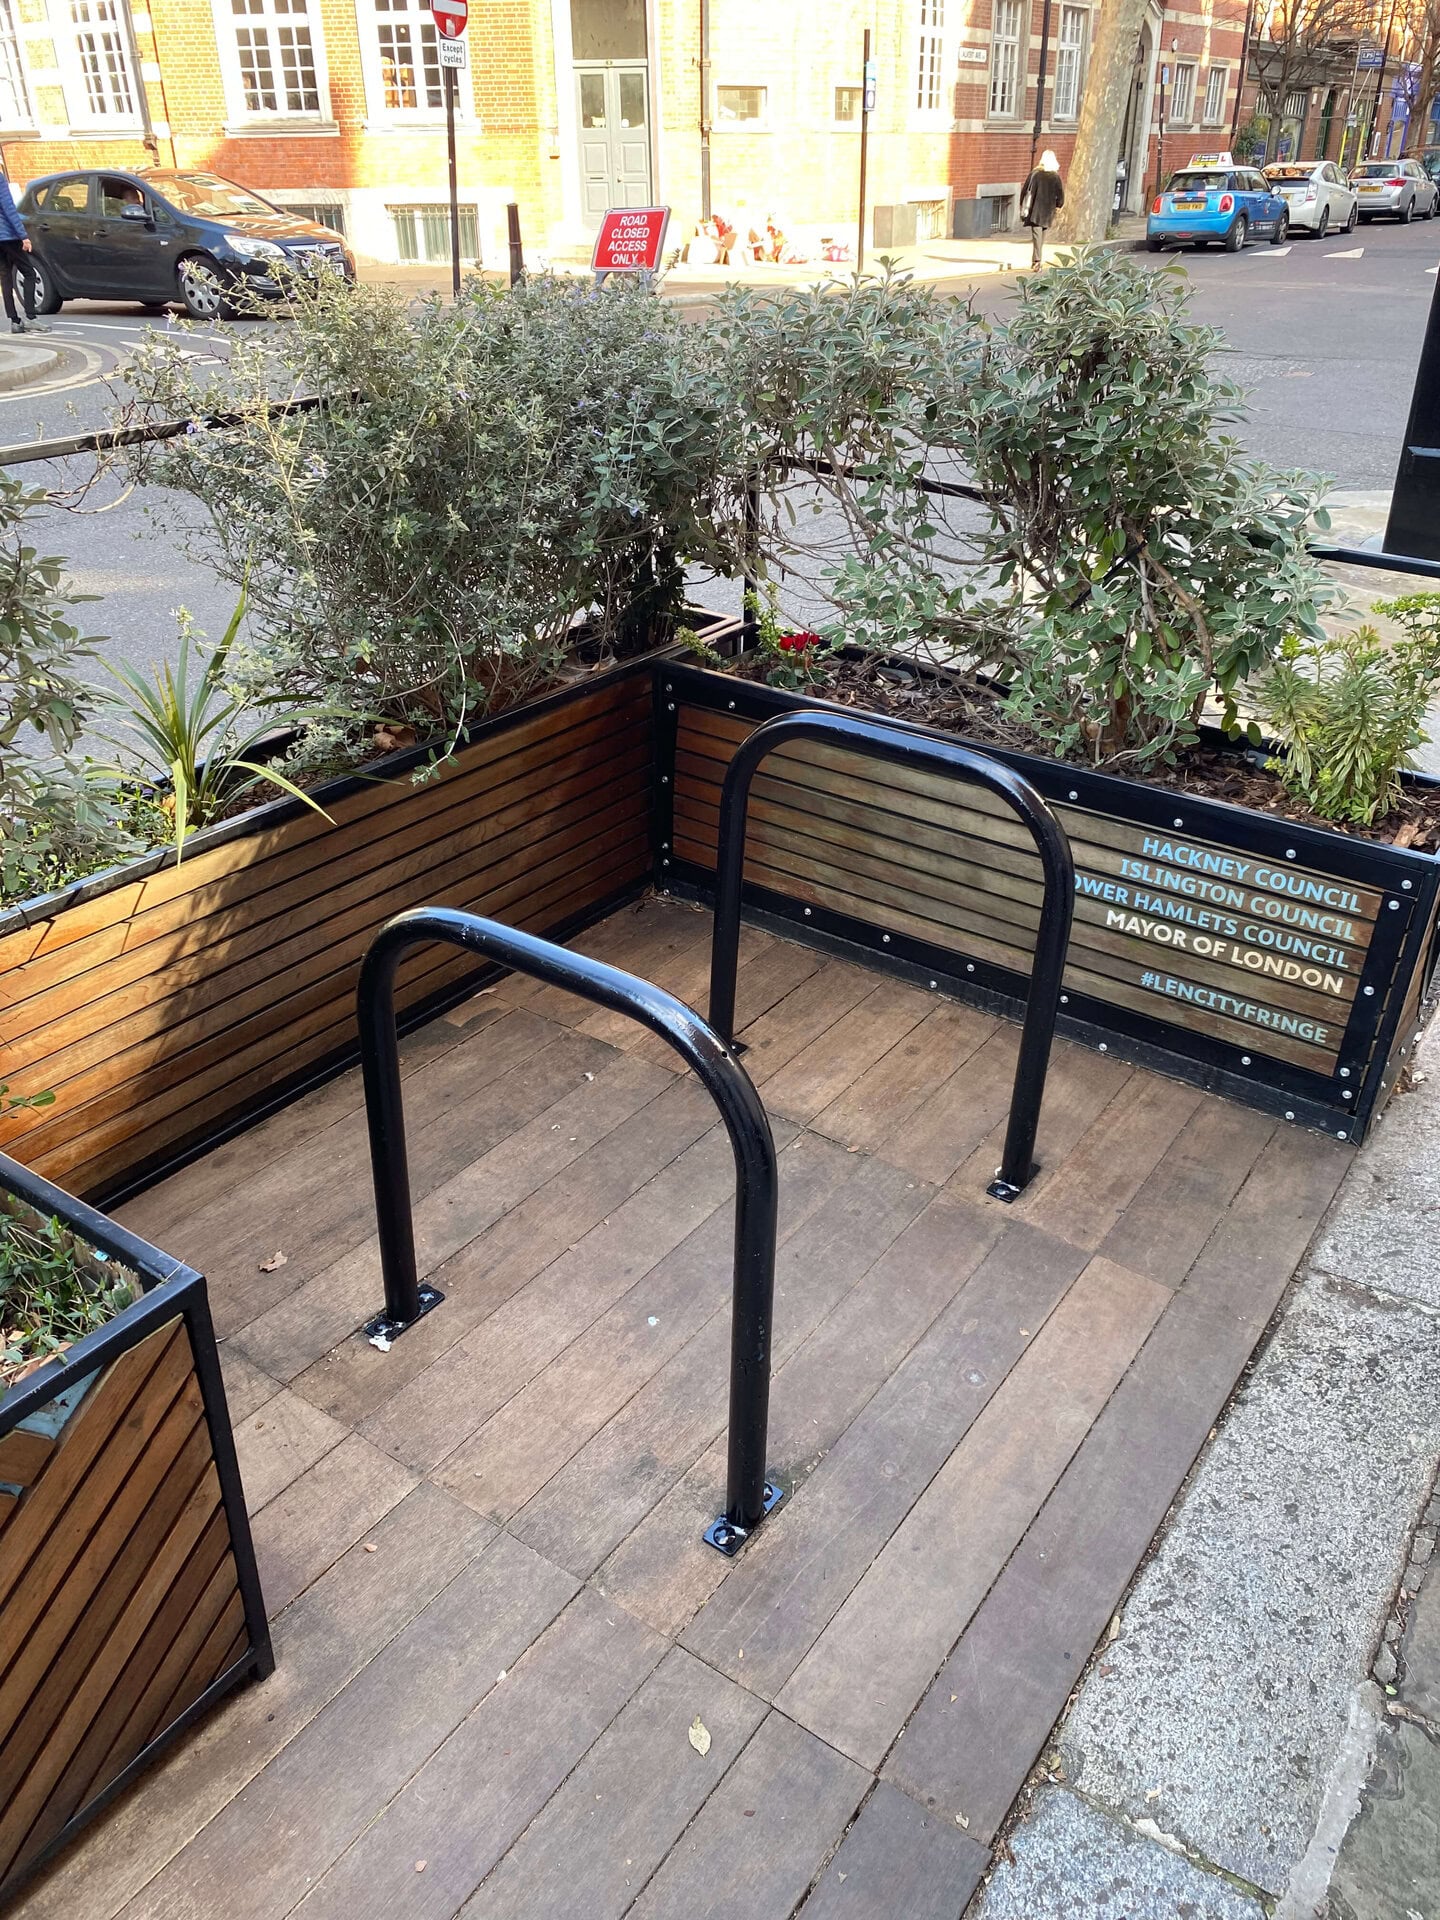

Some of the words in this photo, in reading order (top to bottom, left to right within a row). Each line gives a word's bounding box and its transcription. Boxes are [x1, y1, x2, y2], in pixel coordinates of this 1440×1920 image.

[442, 43, 463, 53] Except
[443, 55, 462, 64] cycles
[620, 214, 648, 226] ROAD
[611, 227, 650, 239] CLOSED
[607, 240, 648, 251] ACCESS
[611, 253, 639, 265] ONLY
[1143, 837, 1250, 880] HACKNEY
[1254, 868, 1362, 913] COUNCIL
[1119, 858, 1244, 909] ISLINGTON
[1250, 896, 1355, 941] COUNCIL
[1074, 874, 1128, 905] WER
[1134, 894, 1238, 936] HAMLETS
[1243, 924, 1349, 969] COUNCIL
[1106, 909, 1186, 948] MAYOR
[1192, 936, 1227, 957] OF
[1230, 946, 1345, 994] LONDON
[1140, 972, 1329, 1044] #LENCITYFRINGE
